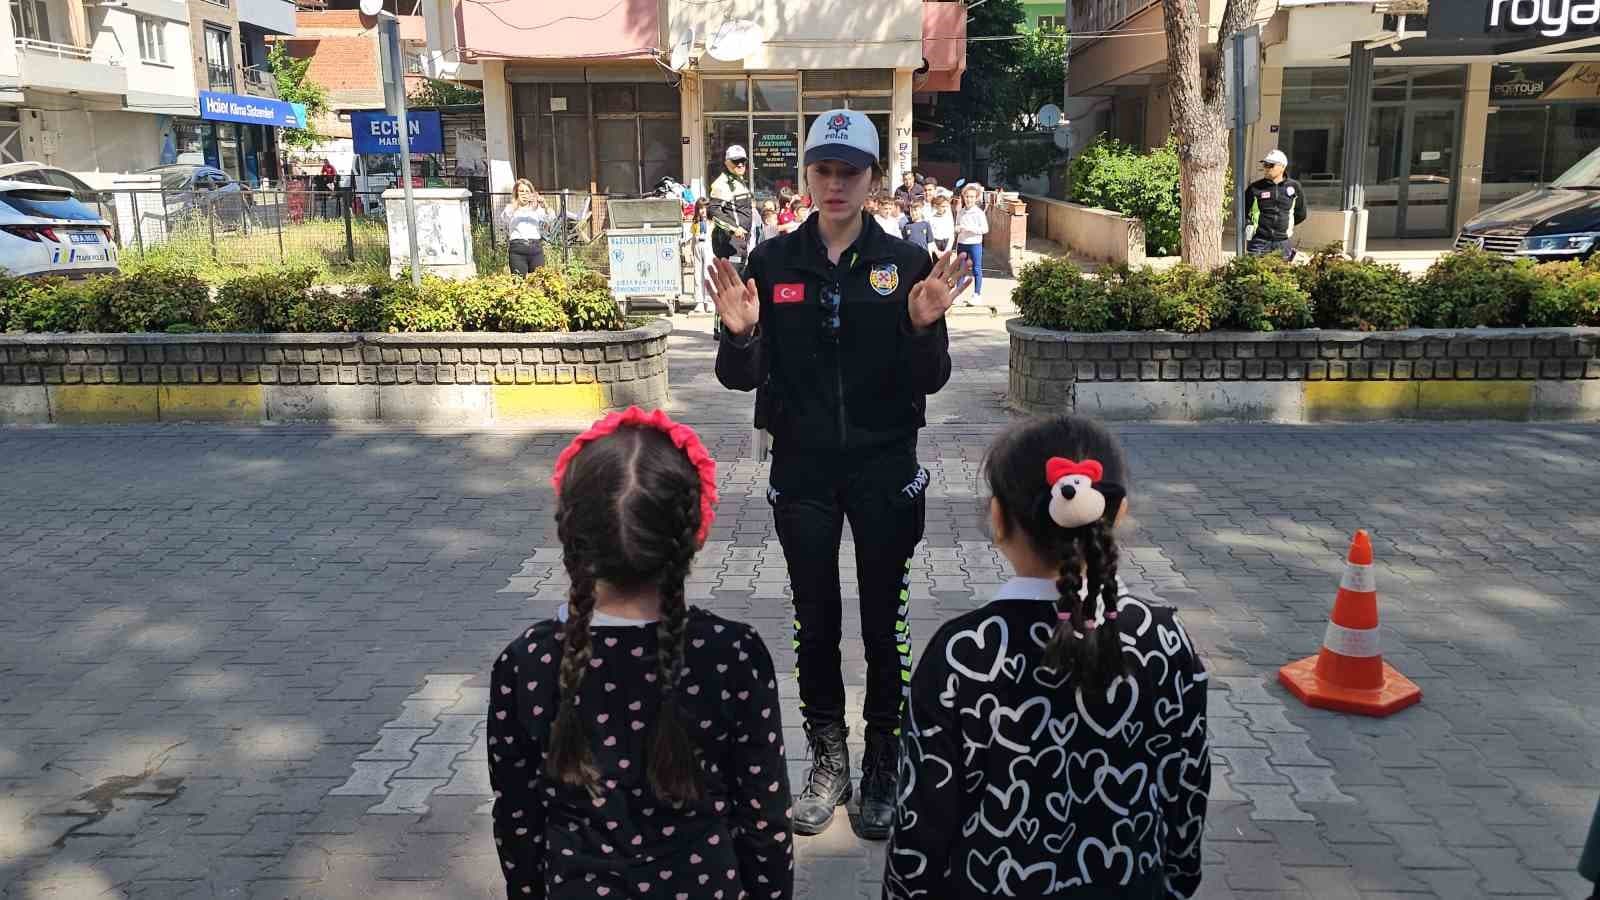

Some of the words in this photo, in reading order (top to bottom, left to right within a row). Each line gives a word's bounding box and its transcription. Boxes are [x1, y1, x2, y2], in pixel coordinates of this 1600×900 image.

[206, 97, 229, 114] Haier
[370, 120, 420, 135] ECRN
[896, 127, 911, 136] TV
